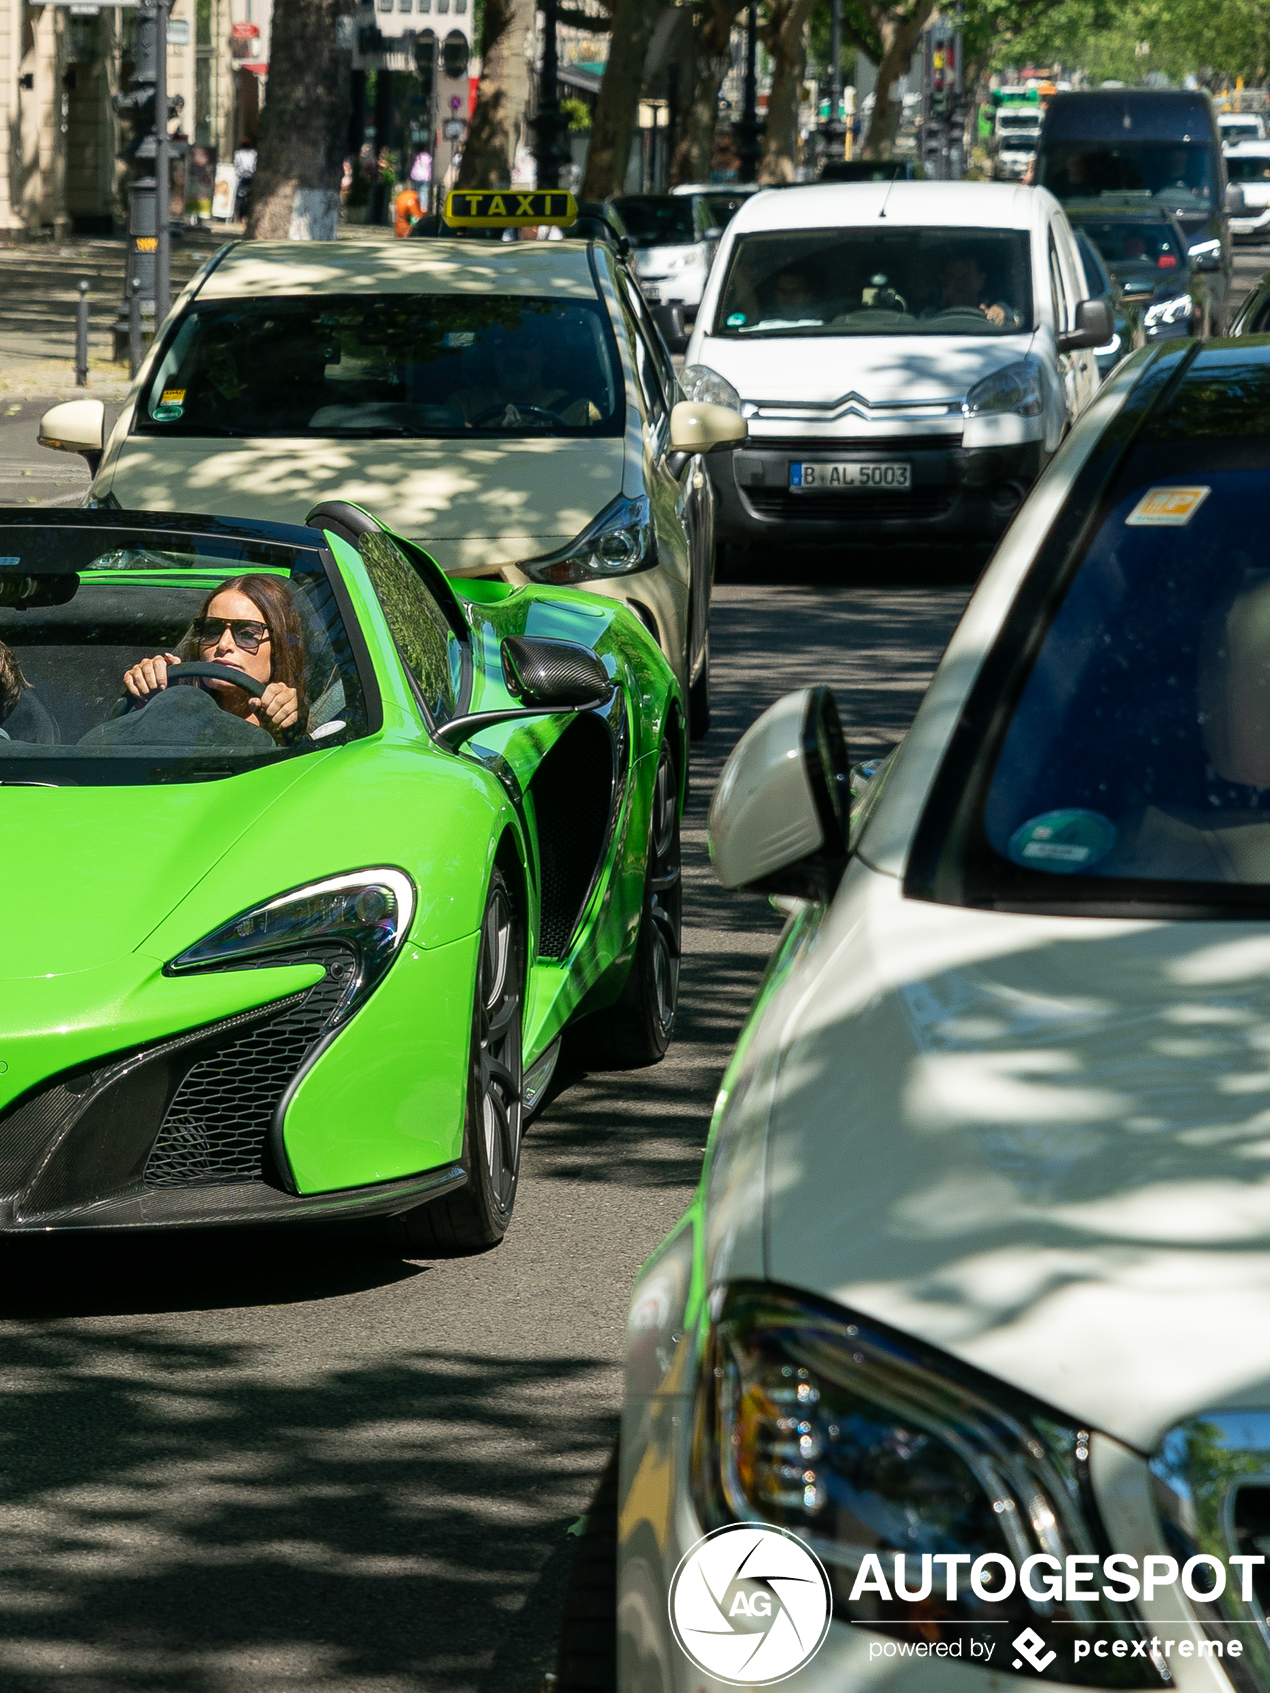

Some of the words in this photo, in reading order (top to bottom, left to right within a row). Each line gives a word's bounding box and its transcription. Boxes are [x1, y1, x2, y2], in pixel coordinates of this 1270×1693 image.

[465, 195, 552, 216] TAXI
[803, 466, 815, 485] B
[829, 466, 854, 485] AL
[859, 466, 908, 486] 5003
